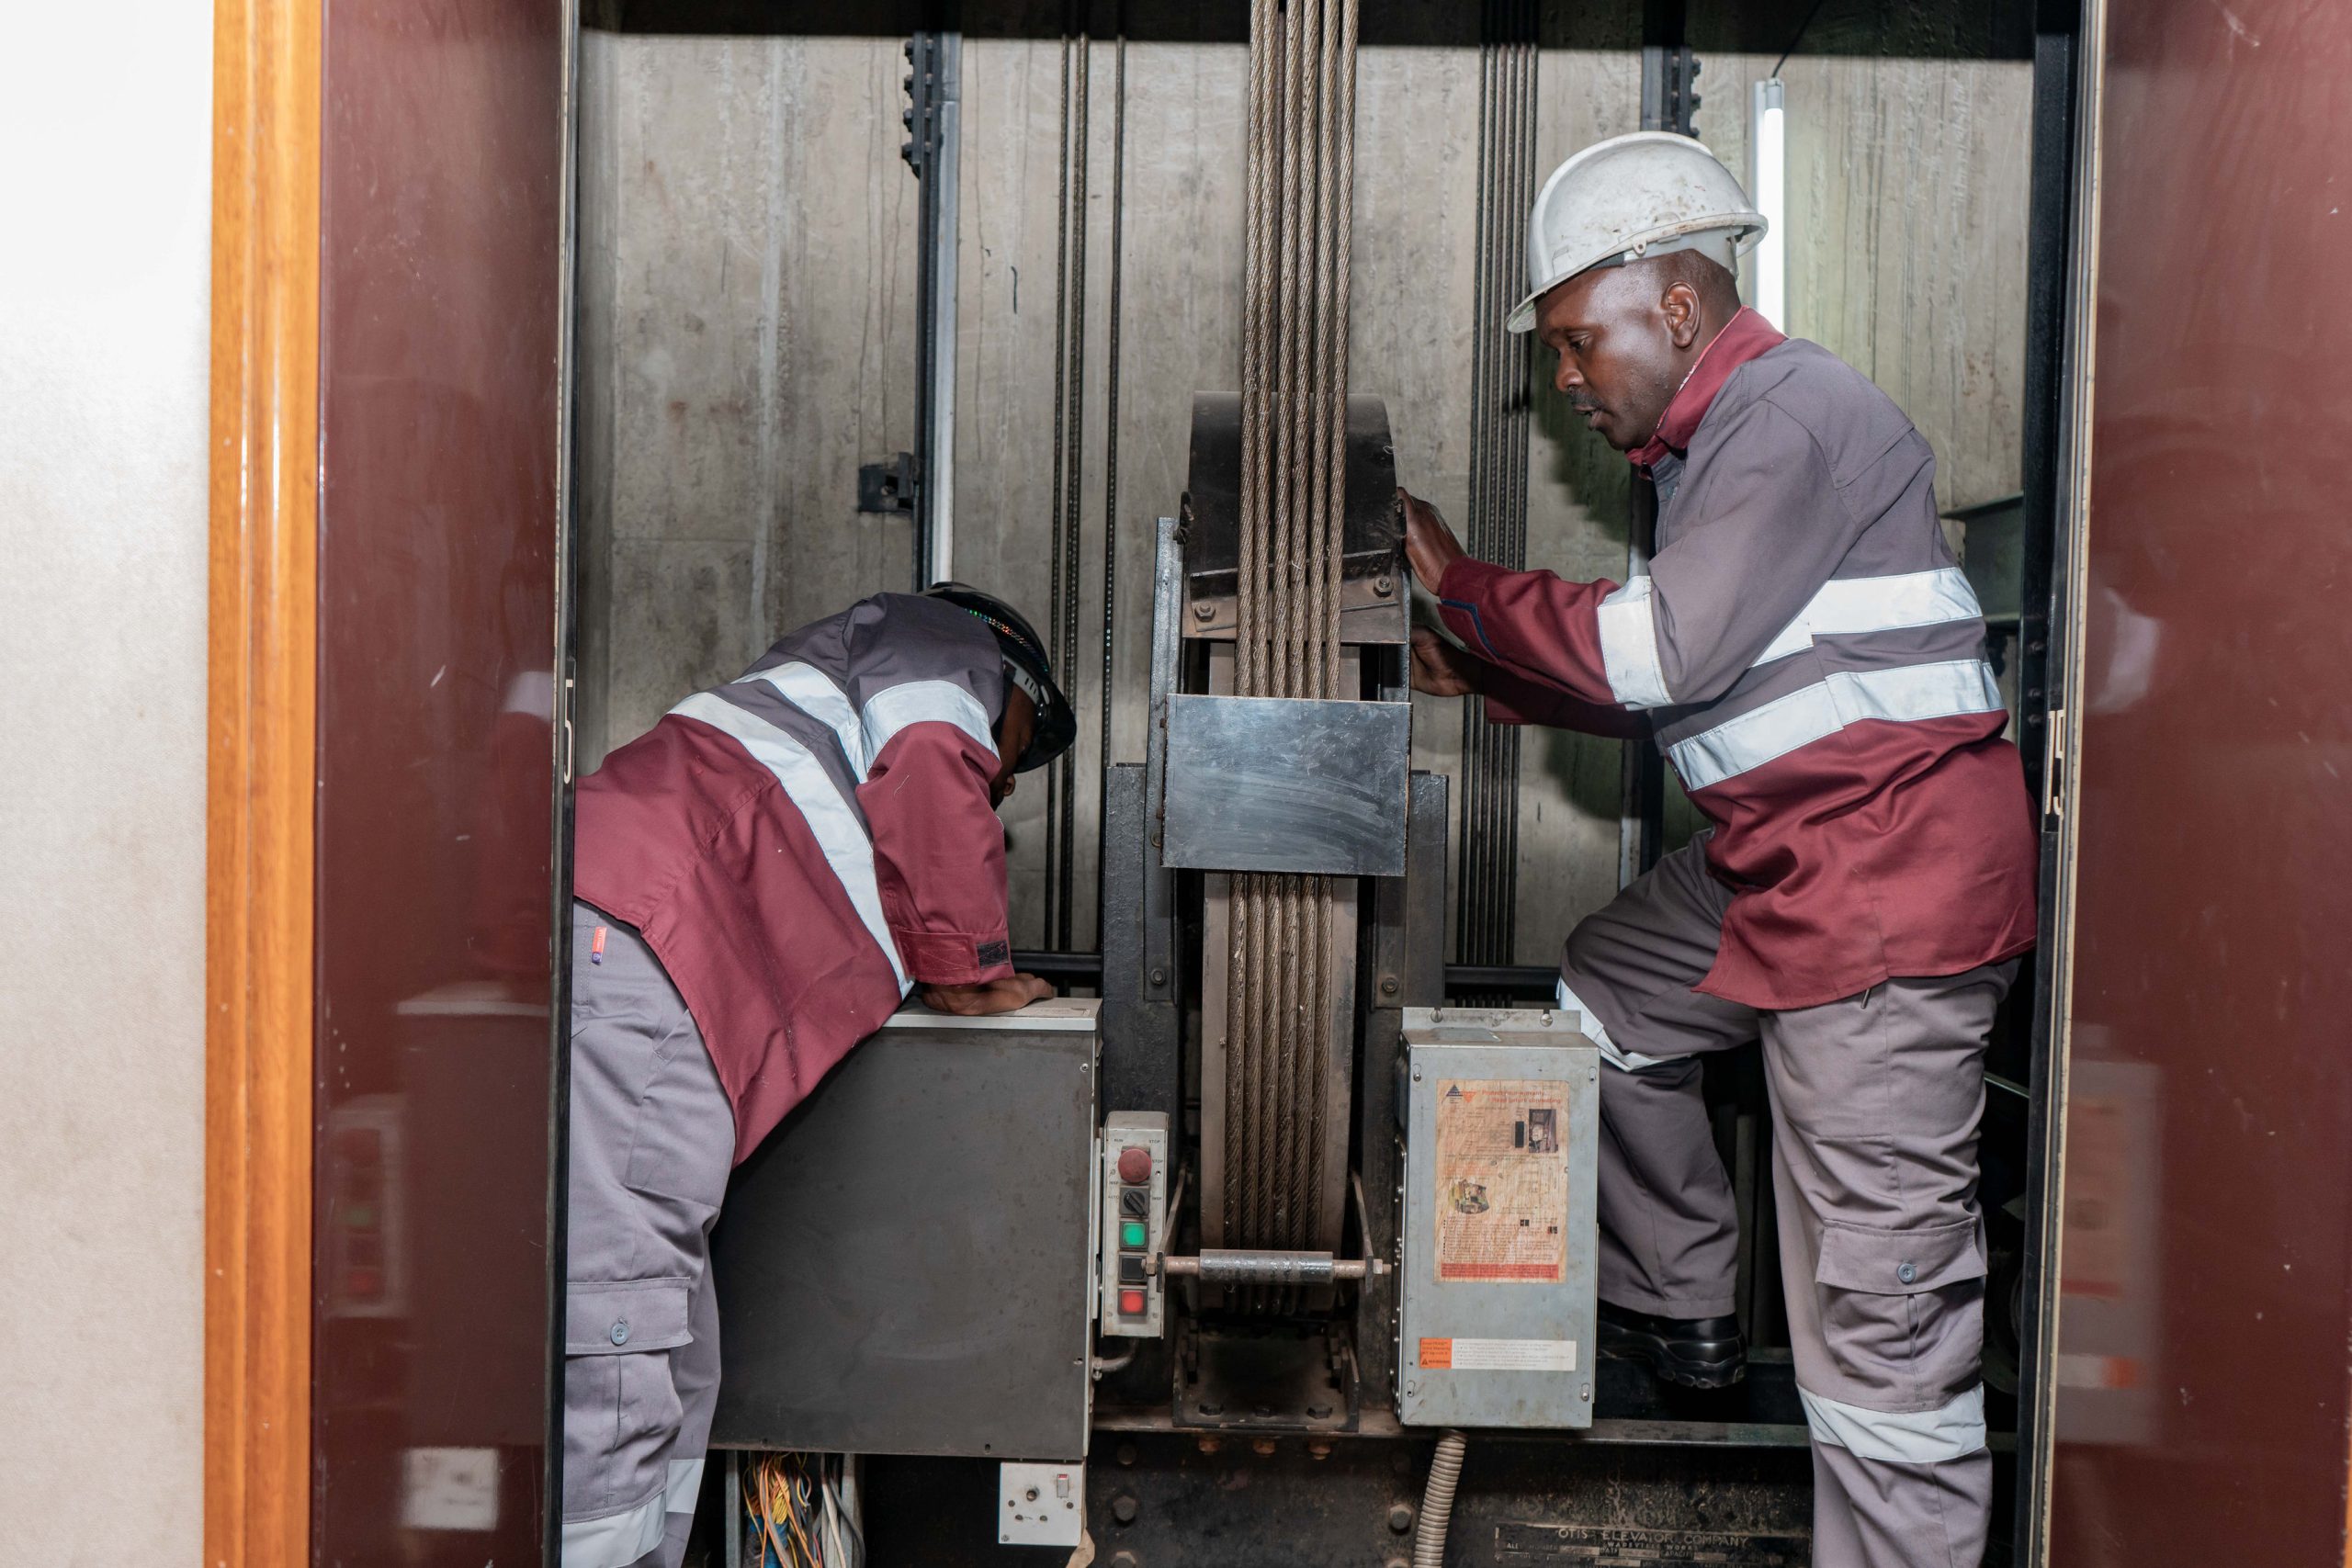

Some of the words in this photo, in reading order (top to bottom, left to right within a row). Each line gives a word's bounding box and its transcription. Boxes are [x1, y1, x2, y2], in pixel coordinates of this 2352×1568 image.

[1558, 1528, 1589, 1540] OTIS
[1601, 1529, 1674, 1545] ELEVATOR
[1683, 1533, 1749, 1549] COMPANY
